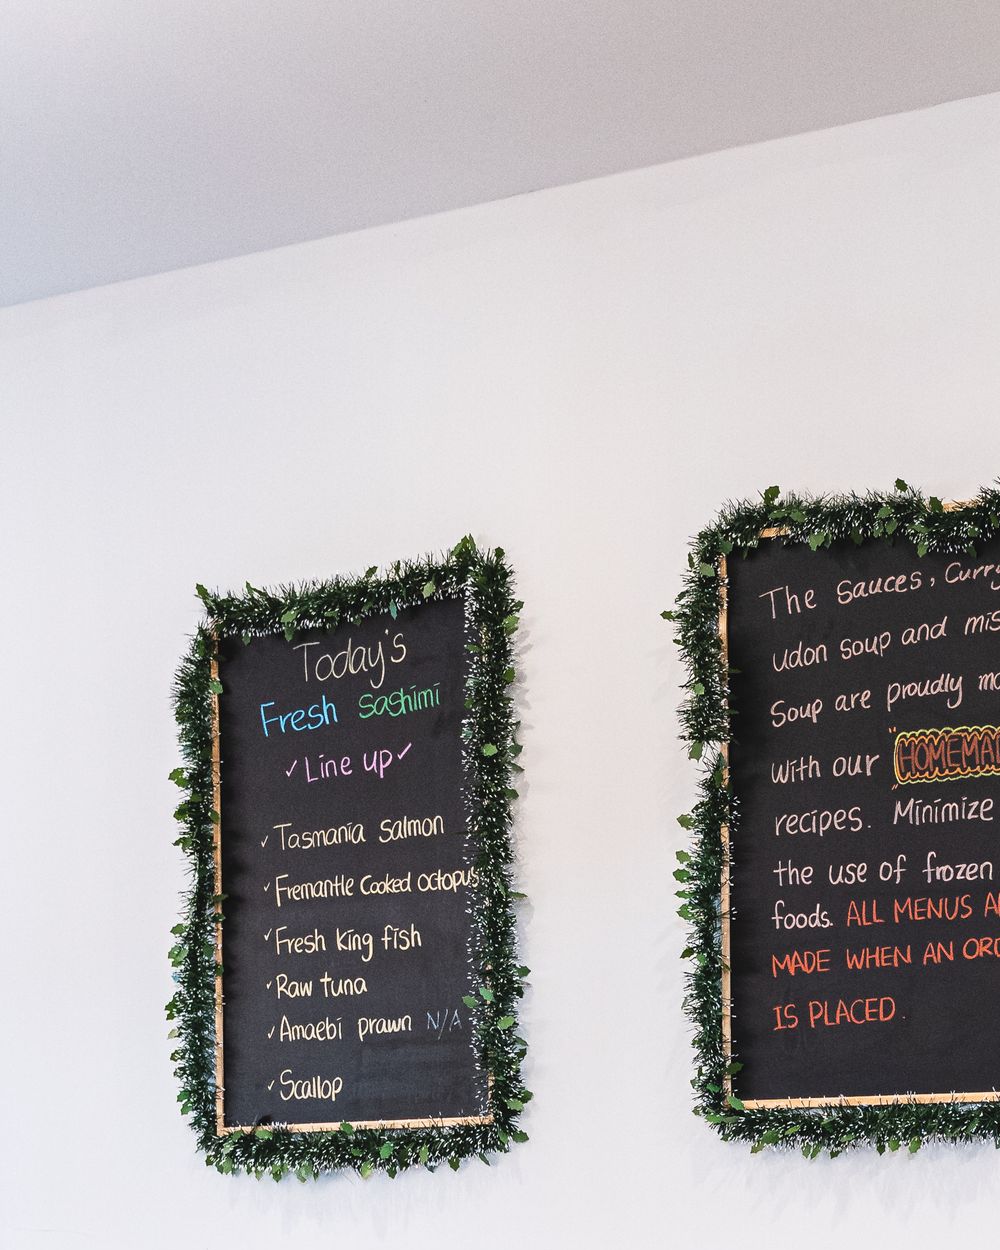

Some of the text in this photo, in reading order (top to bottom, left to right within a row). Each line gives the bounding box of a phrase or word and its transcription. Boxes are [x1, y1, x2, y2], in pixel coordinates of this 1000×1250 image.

[759, 586, 817, 619] The
[901, 617, 947, 647] and
[293, 628, 407, 688] Today's
[834, 686, 872, 712] are
[886, 672, 963, 712] proudly
[260, 694, 338, 737] Fresh
[305, 750, 393, 783] Line up
[832, 752, 880, 778] our
[775, 796, 995, 837] recipes. Minimize
[274, 822, 366, 850] Tasmania
[773, 851, 993, 887] the use of frozen
[275, 874, 354, 907] Fremantle
[771, 900, 834, 931] foods.
[846, 897, 885, 927] ALL
[893, 893, 973, 922] MENUS
[275, 926, 326, 954] Fresh
[381, 923, 422, 949] fish
[771, 948, 831, 978] MADE
[846, 943, 912, 971] WHEN
[923, 941, 954, 966] AN
[275, 971, 367, 999] Raw tuna
[280, 1008, 462, 1042] Amaebi prawn N/A
[772, 1004, 798, 1031] IS
[280, 1069, 343, 1102] Scallop
